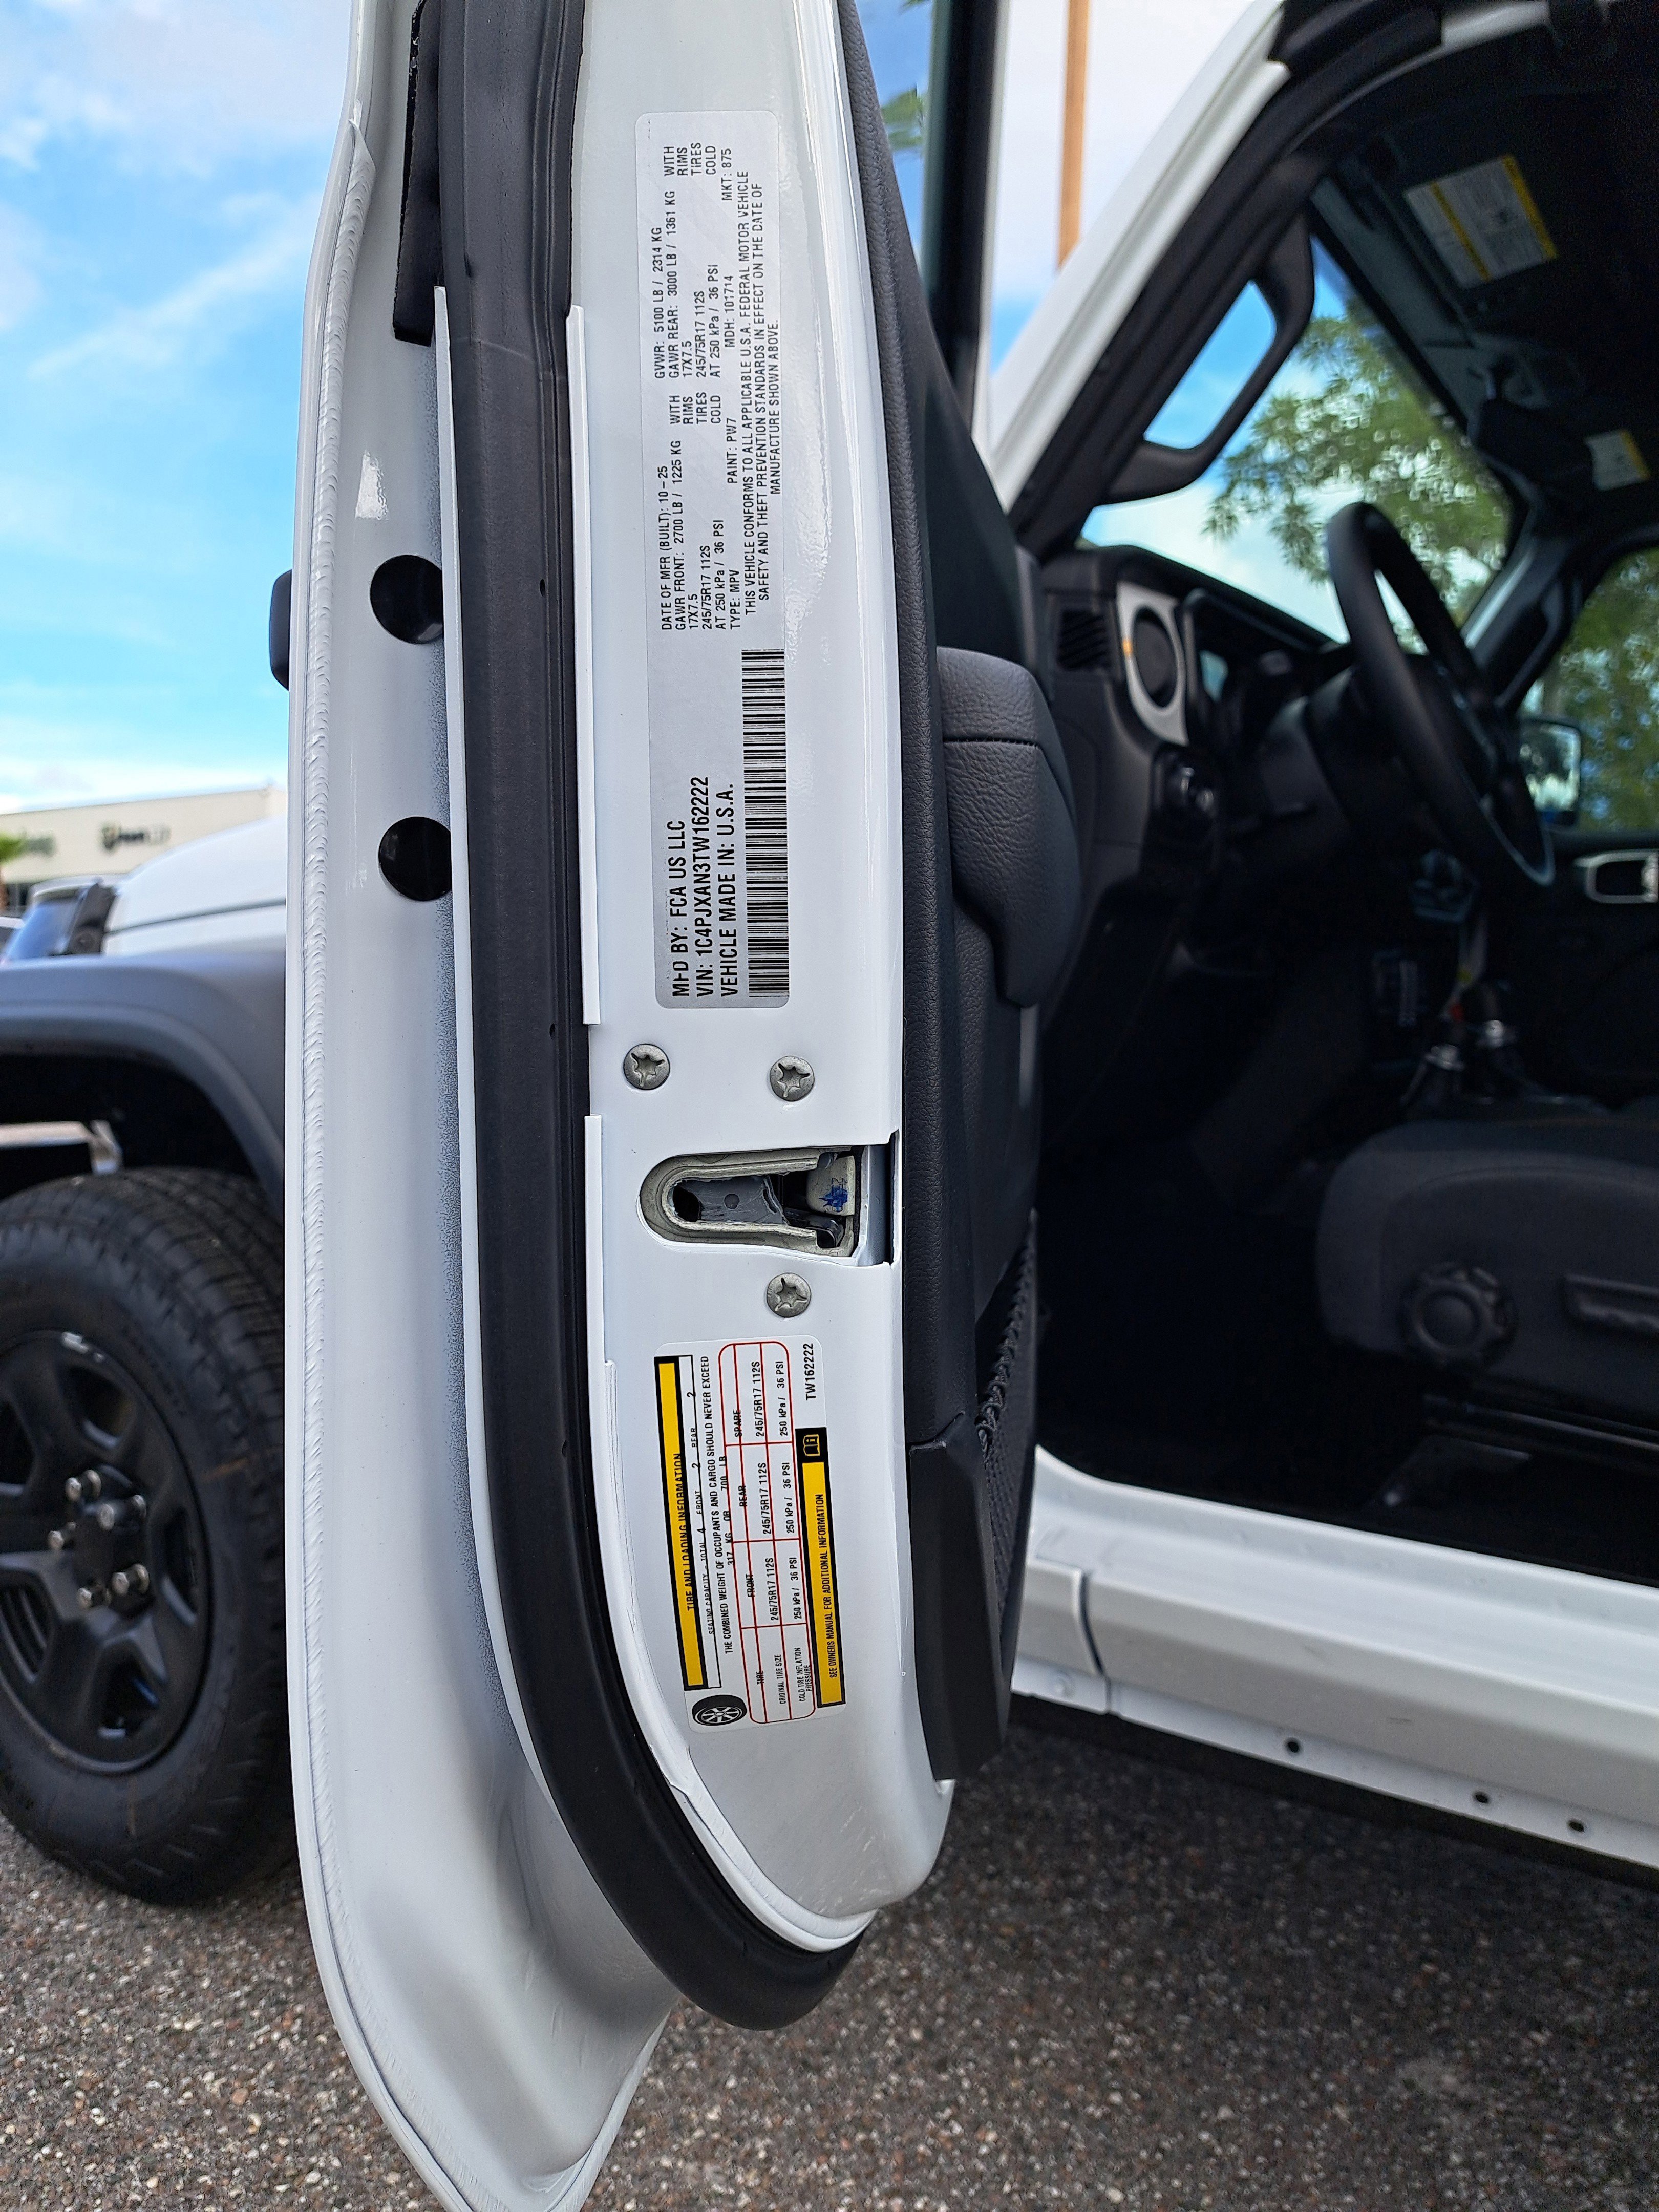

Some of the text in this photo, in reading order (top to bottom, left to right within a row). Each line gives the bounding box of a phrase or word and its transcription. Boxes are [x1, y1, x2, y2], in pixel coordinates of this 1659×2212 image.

[663, 146, 675, 176] WITH
[676, 147, 688, 176] RIMS
[690, 142, 702, 176] TIRES
[705, 146, 716, 175] COLD
[721, 148, 733, 201] MKT: 875
[664, 191, 679, 378] GAWR REAR: 3000 LB 1361 KG
[651, 227, 665, 379] GVWR: 5100 LB 2314 KG
[724, 275, 735, 348] MDH: 101714
[693, 291, 707, 378] 245/75R17 112S
[707, 265, 720, 378] AT 250 kPa 36 PSI
[681, 341, 693, 378] 17X7.5
[695, 392, 708, 424] TIRES
[710, 395, 721, 424] COLD
[737, 171, 756, 615] THIS VEHICLE CONFORMS TO ALL APPLICABLE U.S.A. FEDERAL MOTOR VEHICLE
[751, 183, 769, 601] SAFETY AND THEFT PREVENTION STANDARDS IN EFFECT ON THE DATE OF
[767, 320, 781, 494] MANUFACTURE SHOWN ABOVE.
[669, 395, 681, 425] WITH
[682, 396, 694, 424] RIMS
[726, 417, 738, 483] PAINT: PW7
[658, 508, 673, 551] (BUILT):
[670, 440, 686, 630] GAWR FRONT: 2700 LB 1225 KG
[660, 556, 671, 579] MFR
[713, 520, 726, 630] AT 250 kPa 36 PSI
[660, 584, 671, 598] OF
[699, 545, 712, 630] 245/75R17 112S
[729, 569, 741, 630] TYPE: MPV
[661, 602, 672, 630] DATE
[688, 593, 699, 630] 17X7.5
[667, 821, 685, 849] LLC
[668, 857, 687, 879] US
[669, 886, 688, 917] FCA
[690, 777, 714, 997] VIN: 1C4PJXAN3TW162222
[716, 784, 738, 997] VEHICLE MADE IN: U.S.A.
[670, 927, 688, 953] BY:
[775, 1360, 784, 1375] PSI
[776, 1378, 785, 1389] 36
[802, 1343, 816, 1401] TW162222
[751, 1361, 764, 1437] 245/75R17 112S
[733, 1409, 742, 1438] SPARE
[779, 1421, 788, 1436] 250
[781, 1462, 791, 1476] PSI
[782, 1479, 791, 1489] 36
[673, 1453, 686, 1521] INFORMATION
[738, 1485, 748, 1507] REAR
[757, 1462, 772, 1535] 245/75R17 112S
[700, 1356, 733, 1654] THE COMBINED WEIGHT OF OCCUPANTS AND CARGO SHOULD NEVER EXCEED
[718, 1456, 734, 1566] 317 KG OR 700 LB
[785, 1520, 795, 1534] 250
[683, 1569, 692, 1587] AND
[789, 1557, 798, 1569] PSI
[790, 1571, 798, 1581] 36
[685, 1591, 695, 1611] TIRE
[765, 1557, 779, 1621] 245/75R17 112S
[815, 1494, 838, 1678] SEE OWNERS MANUAL FOR ADDITIONAL INFORMATION
[793, 1607, 802, 1620] 250
[774, 1654, 786, 1705] ORIGINAL TIRE SIZE
[794, 1647, 806, 1701] COLD TIRE INFLATION
[803, 1664, 813, 1692] PRESSURE
